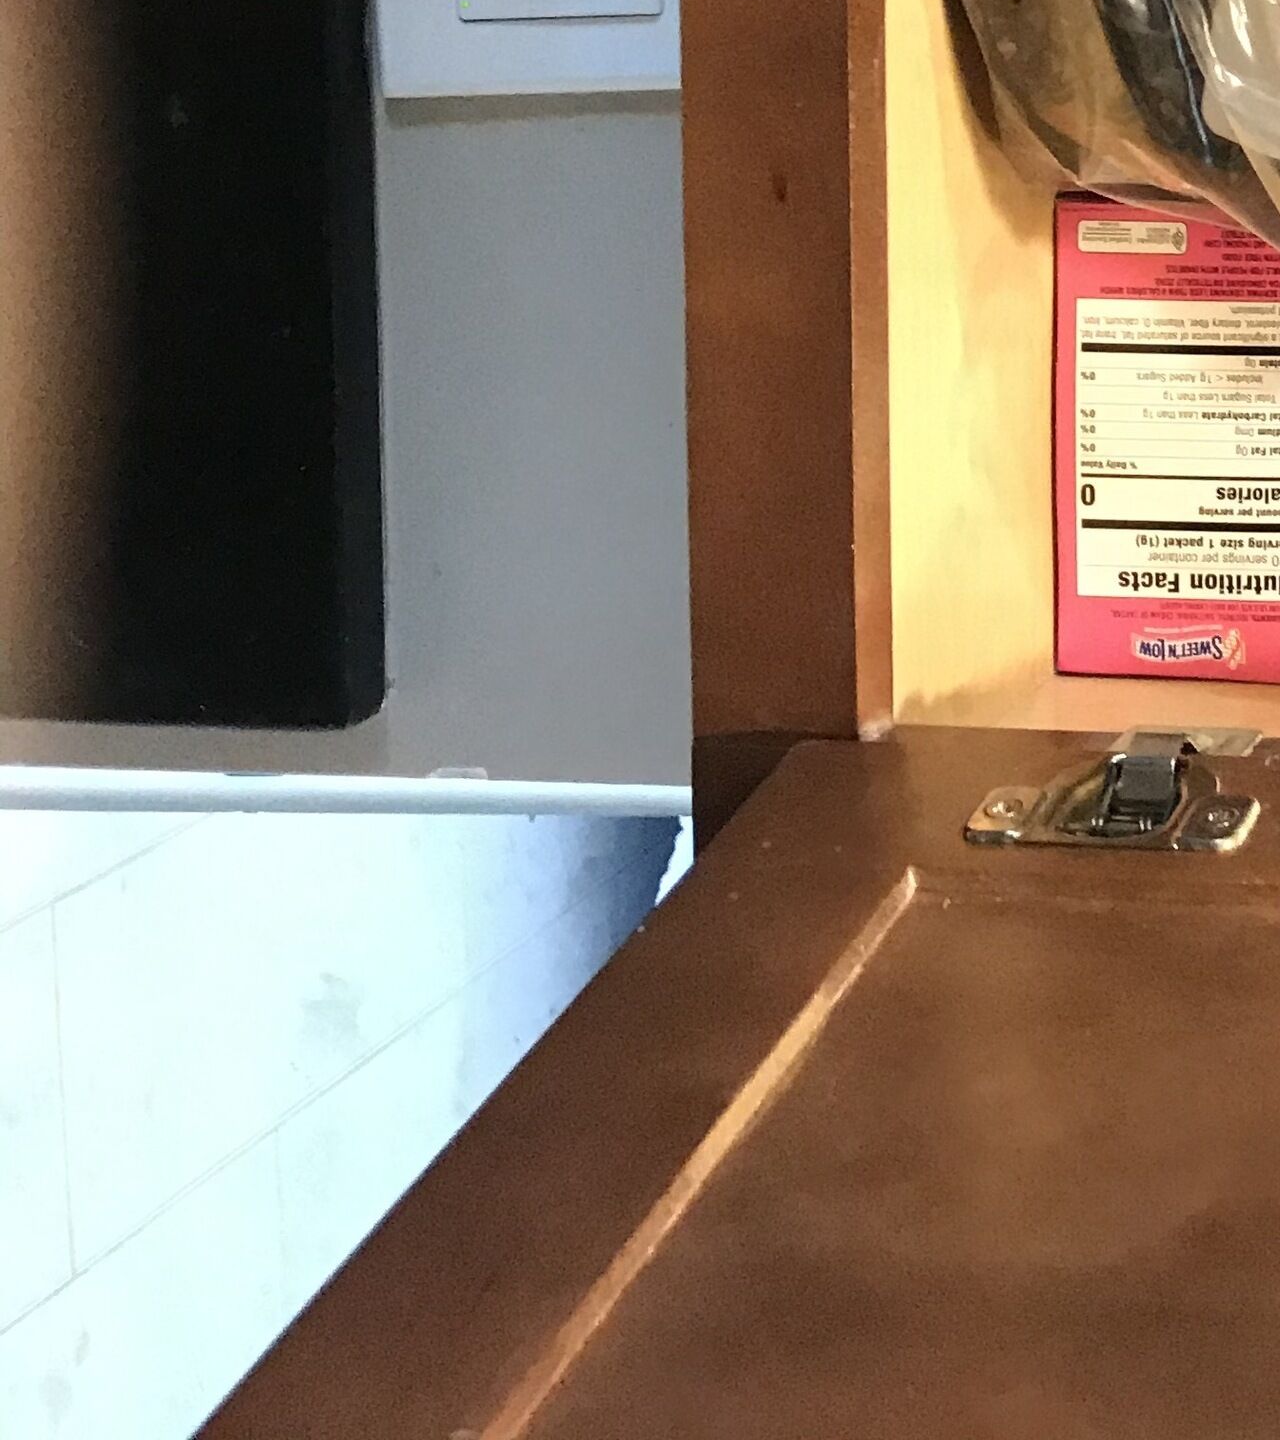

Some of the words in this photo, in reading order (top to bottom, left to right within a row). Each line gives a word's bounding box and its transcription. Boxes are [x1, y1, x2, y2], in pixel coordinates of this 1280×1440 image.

[1254, 394, 1277, 404] Total
[1178, 410, 1199, 420] Less
[1201, 410, 1267, 421] Carbohydrate
[1251, 446, 1266, 456] Fat
[1080, 460, 1104, 469] Value
[1106, 459, 1127, 470] Daily
[1080, 484, 1096, 506] 0
[1198, 507, 1235, 518] serving
[1237, 507, 1253, 517] per
[1135, 535, 1160, 549] (1g)
[1163, 536, 1204, 550] packet
[1220, 539, 1244, 550] size
[1147, 552, 1199, 564] container
[1201, 549, 1219, 564] per
[1222, 552, 1268, 566] servings
[1118, 571, 1180, 594] Facts
[1139, 638, 1165, 661] LOW
[1168, 635, 1223, 661] SWEET'N
